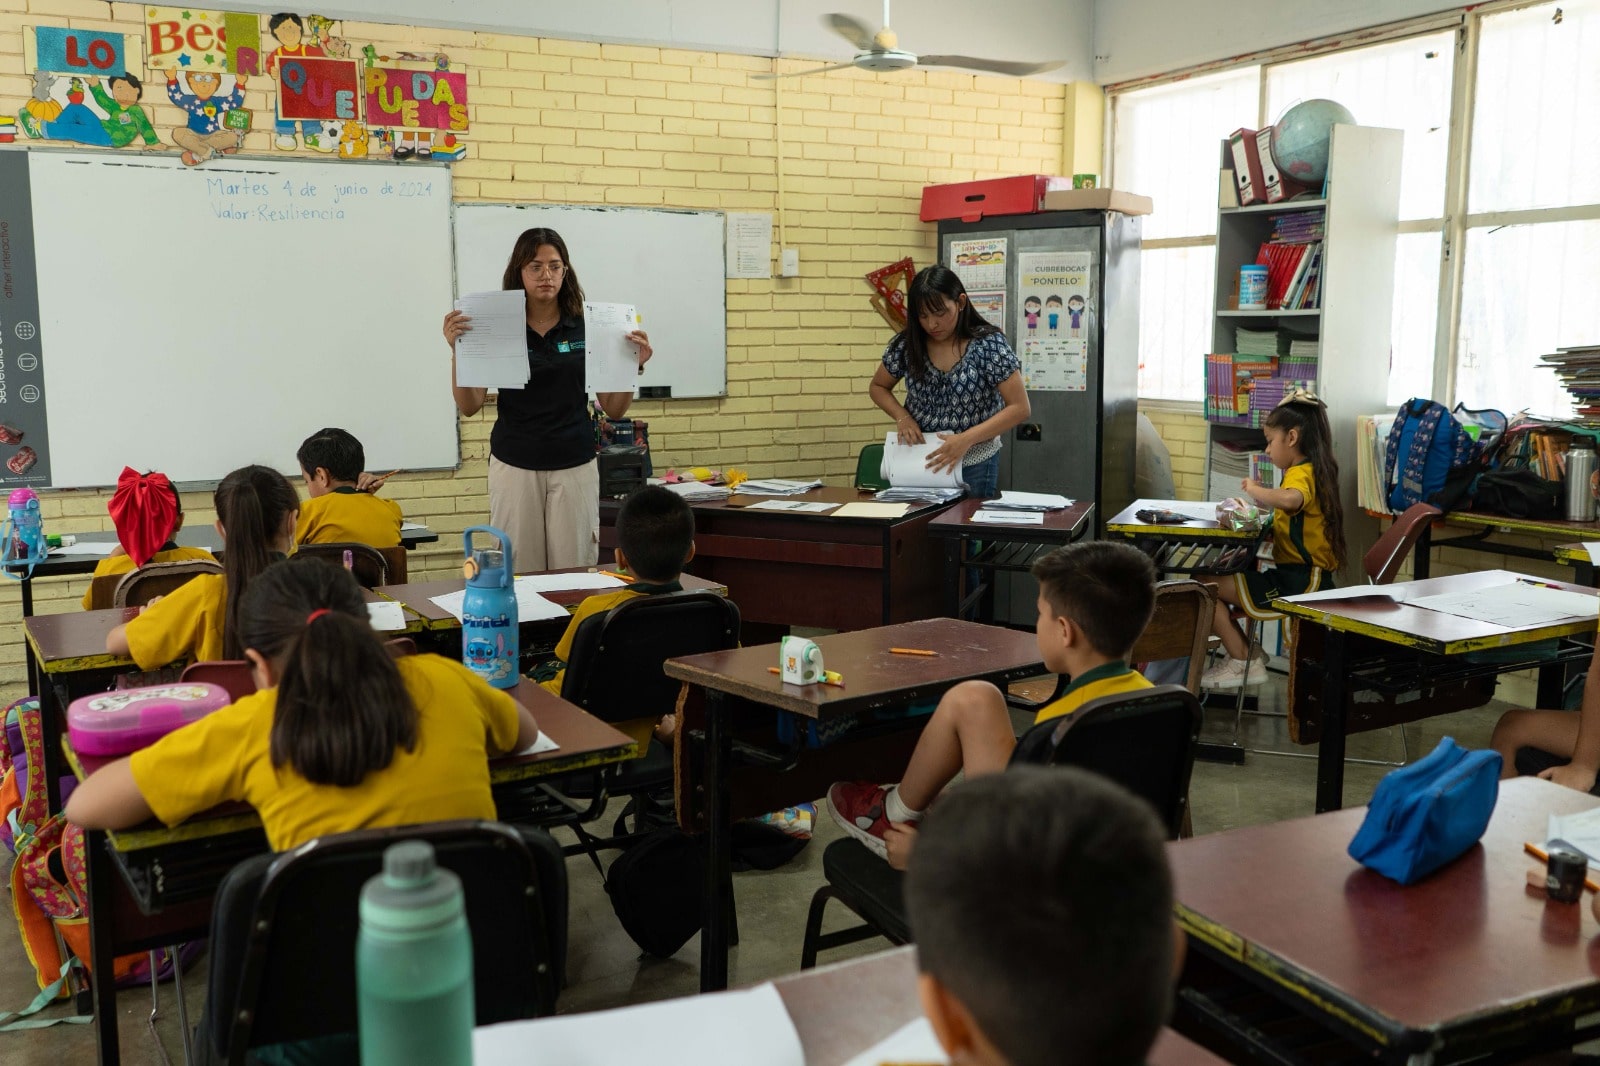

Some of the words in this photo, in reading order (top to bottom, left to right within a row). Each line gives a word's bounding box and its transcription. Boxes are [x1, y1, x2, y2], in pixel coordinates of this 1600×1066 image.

[65, 35, 116, 70] LO
[236, 46, 259, 76] R
[281, 61, 355, 119] QUE
[365, 67, 468, 131] PUEDAS
[206, 177, 269, 196] Martes
[283, 180, 293, 197] 4
[300, 181, 317, 197] de
[334, 182, 368, 204] junio
[380, 181, 394, 195] de
[399, 181, 432, 197] 2024
[1034, 265, 1087, 273] CUBREBOCAS
